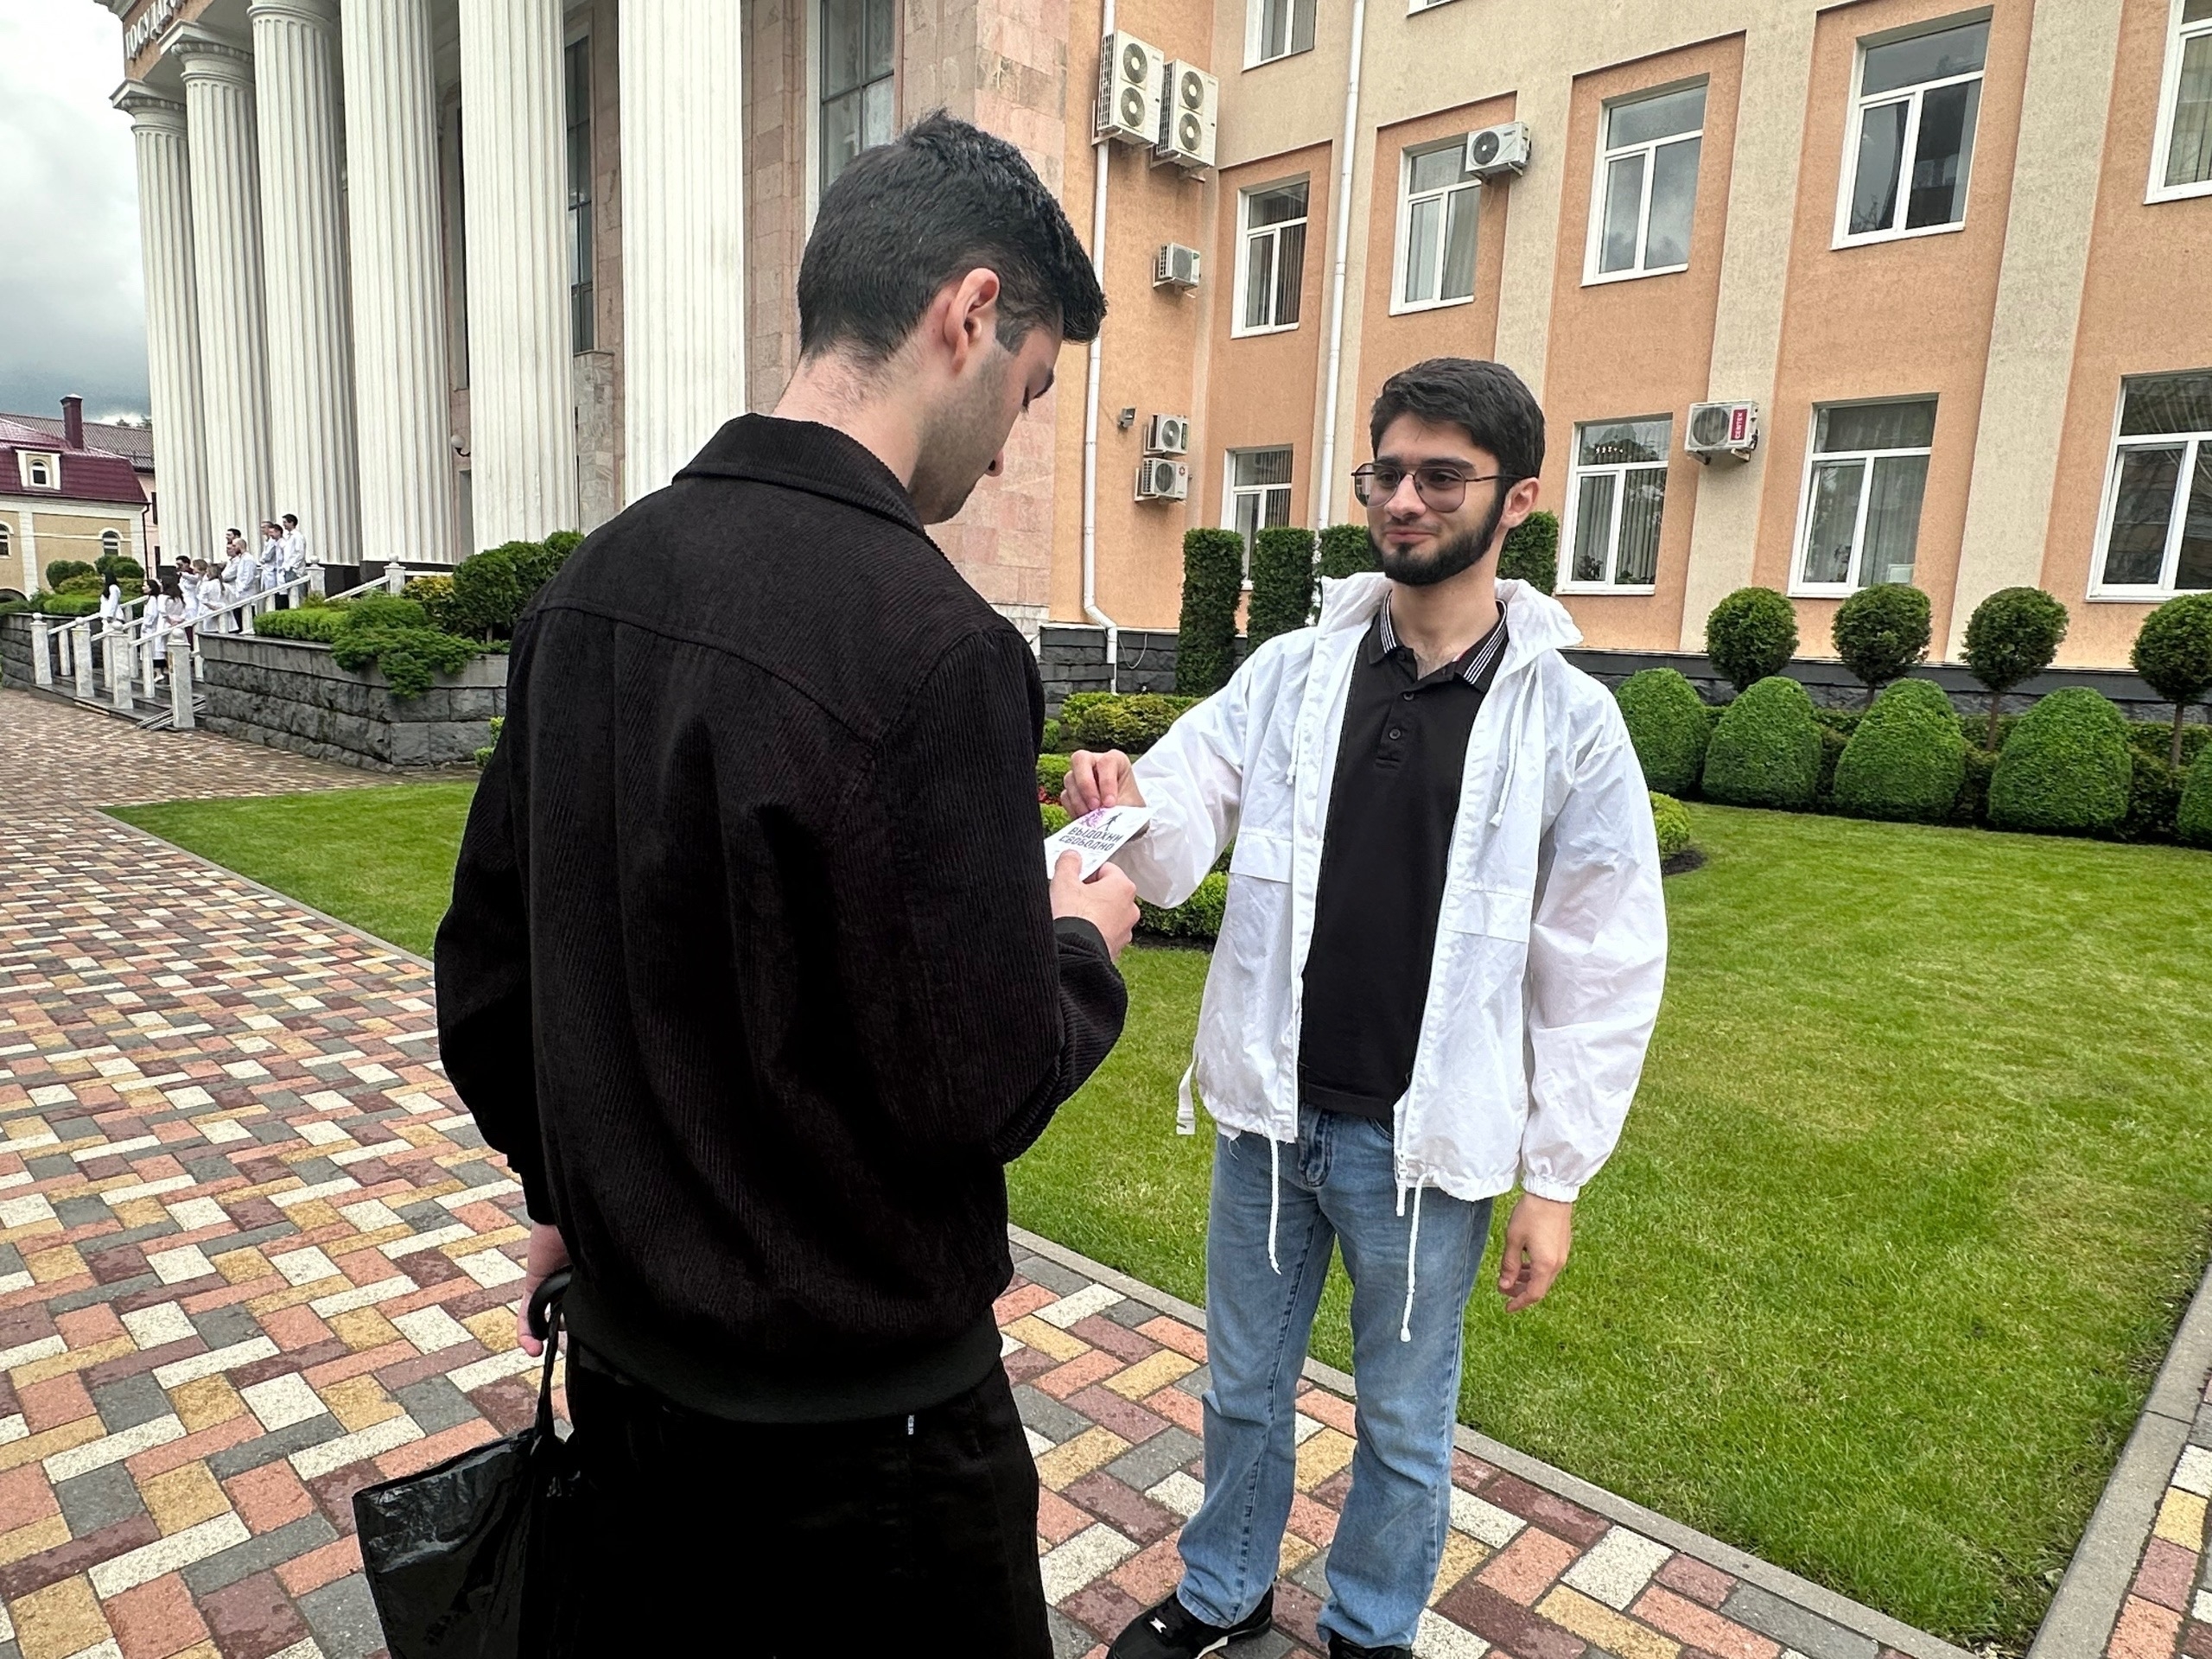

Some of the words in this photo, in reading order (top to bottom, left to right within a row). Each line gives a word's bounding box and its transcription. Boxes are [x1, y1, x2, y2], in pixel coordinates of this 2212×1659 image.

[125, 0, 176, 59] ГОСУДА
[1068, 827, 1124, 842] ВЫДОХНИ
[1058, 835, 1115, 851] СВОБОДНО
